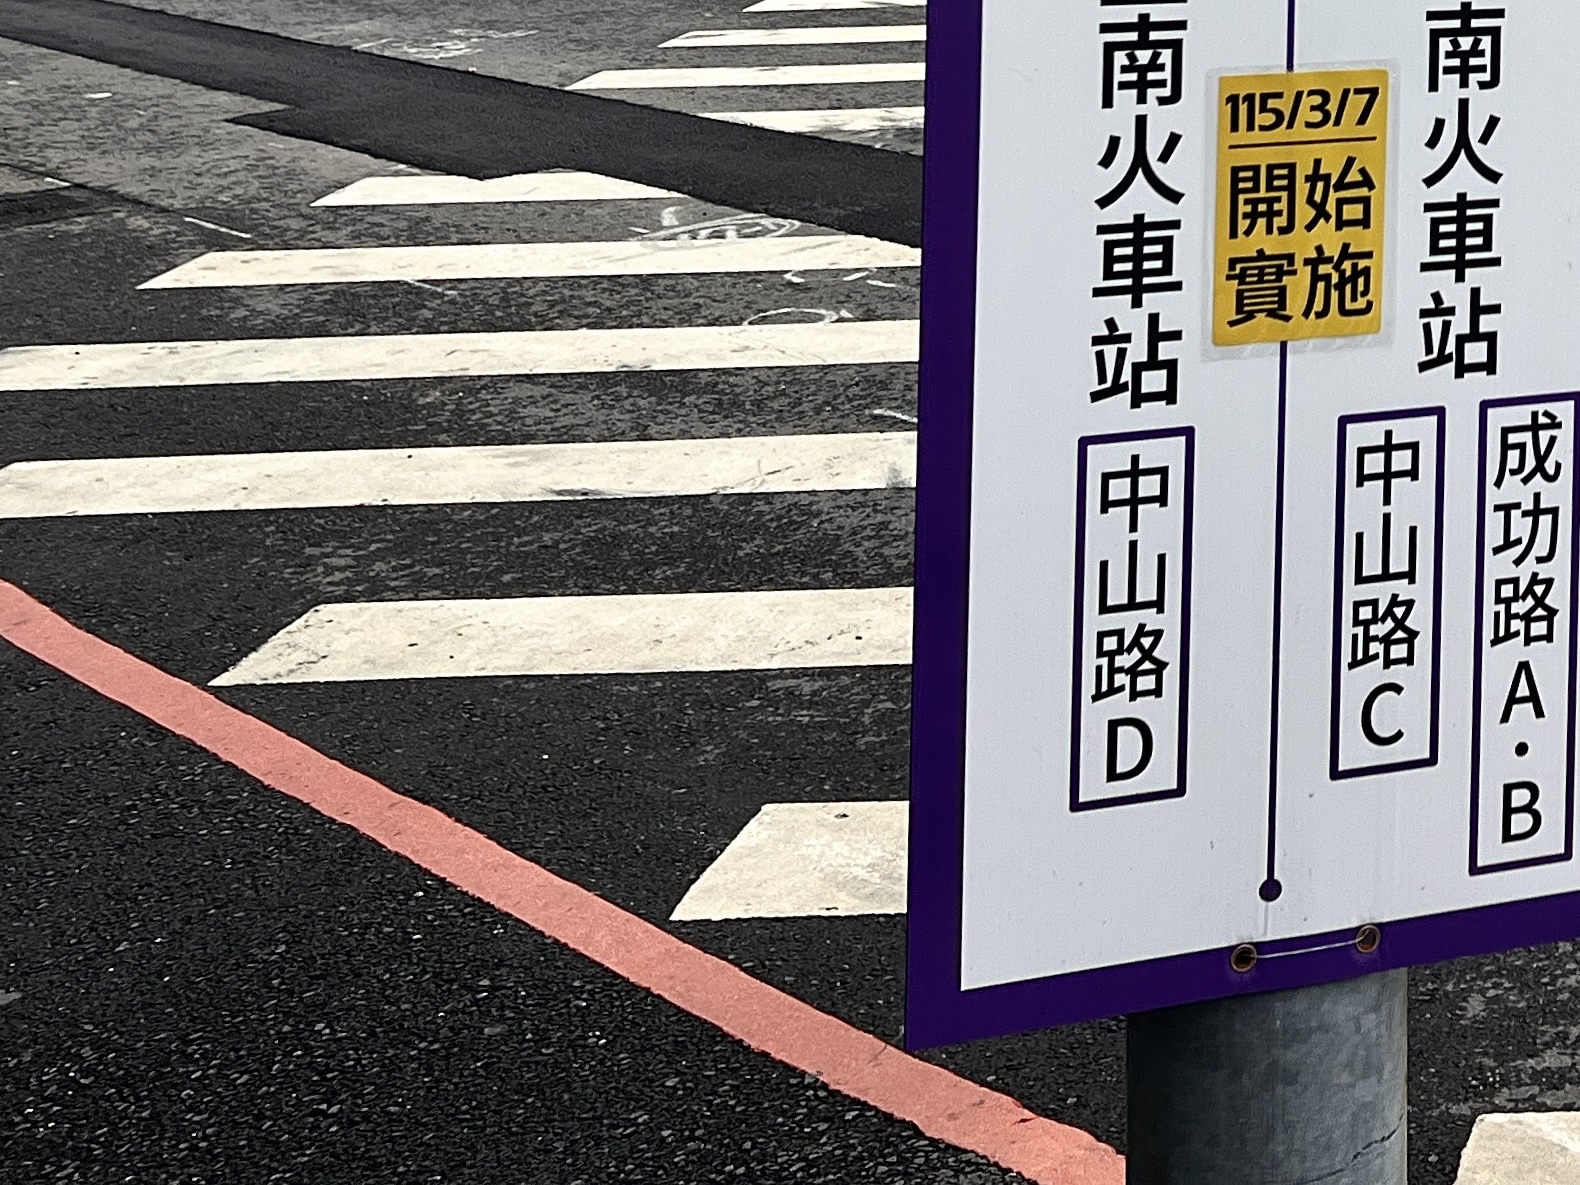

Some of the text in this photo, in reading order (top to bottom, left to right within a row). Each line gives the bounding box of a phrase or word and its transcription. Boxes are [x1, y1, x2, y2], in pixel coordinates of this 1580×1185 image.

[1224, 86, 1381, 134] 115/3/7
[1227, 155, 1377, 240] 開始
[1225, 242, 1375, 329] 實施
[1090, 453, 1171, 784] 中山路D
[1346, 428, 1422, 747] 中山路C
